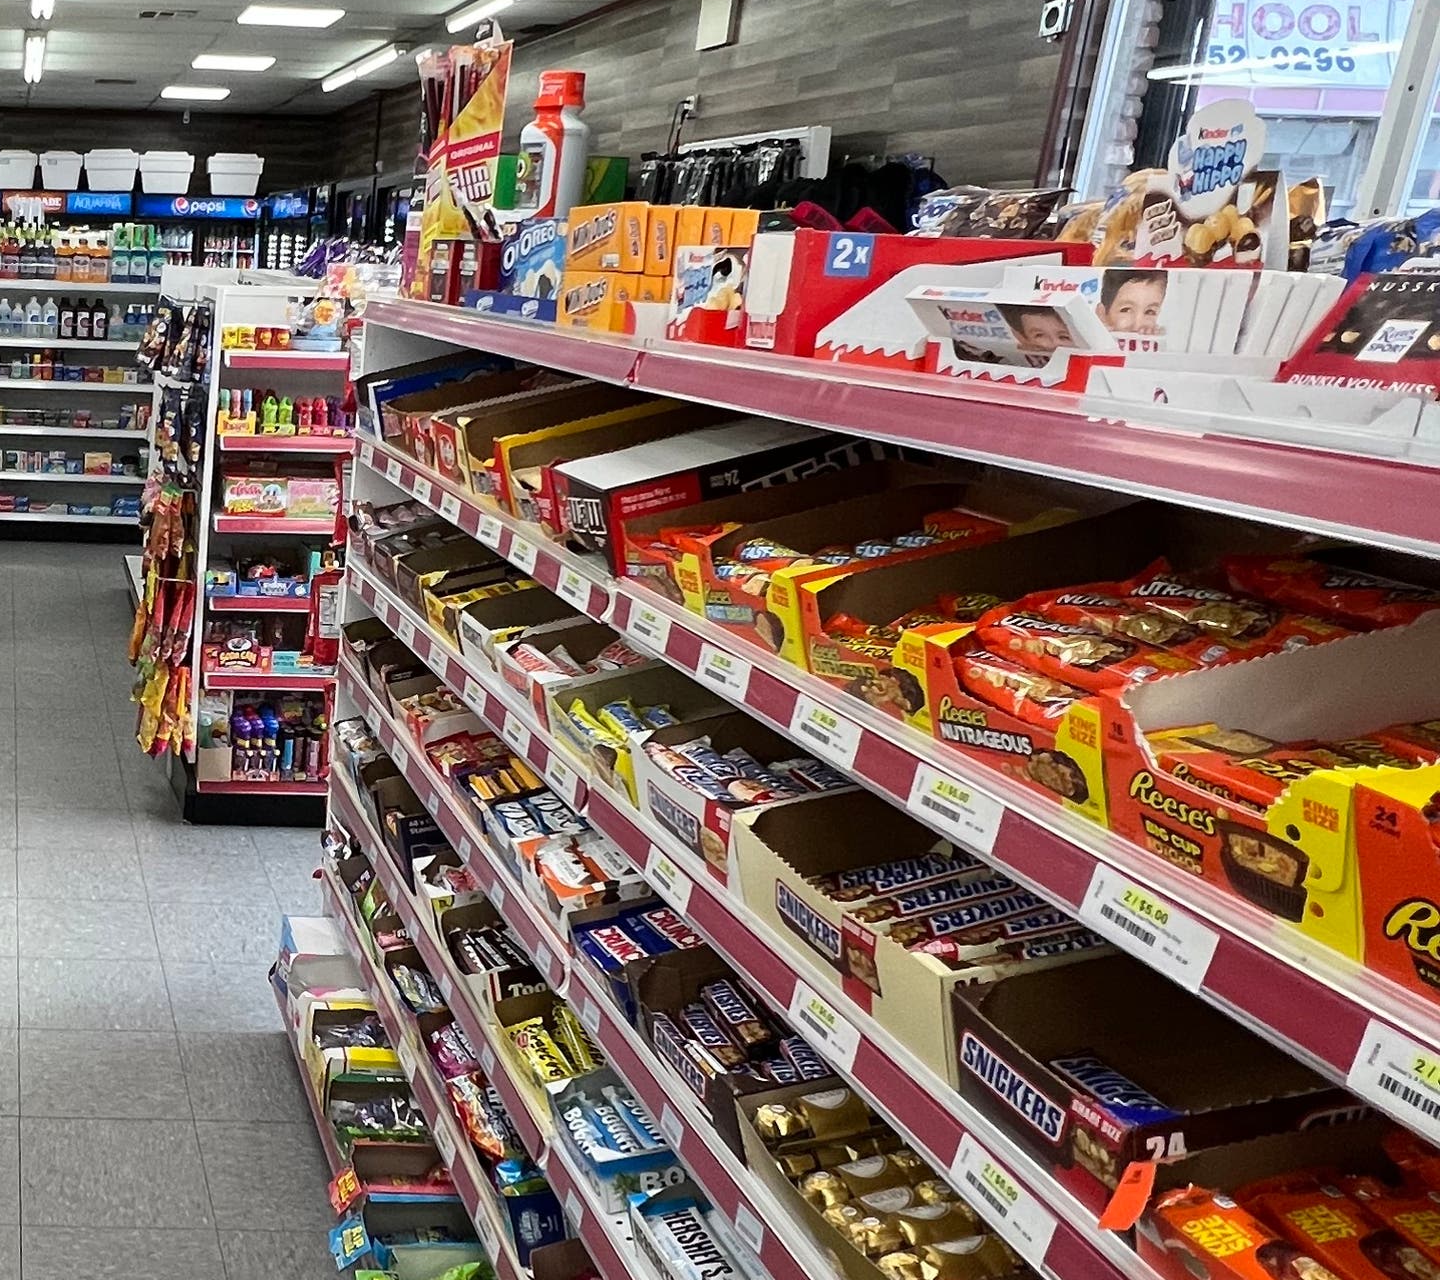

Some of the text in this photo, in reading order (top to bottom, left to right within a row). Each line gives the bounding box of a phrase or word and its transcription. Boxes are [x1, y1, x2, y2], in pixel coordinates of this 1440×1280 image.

[190, 200, 227, 215] pepsi
[1069, 716, 1097, 735] KING
[940, 721, 1033, 755] NUTRAGEOUS
[1069, 729, 1097, 749] SIZE
[1302, 798, 1339, 818] KING
[1302, 811, 1340, 833] SIZE
[1171, 832, 1202, 856] CUP
[776, 883, 841, 959] SNICKERS
[962, 1036, 1064, 1140] SNICKERS
